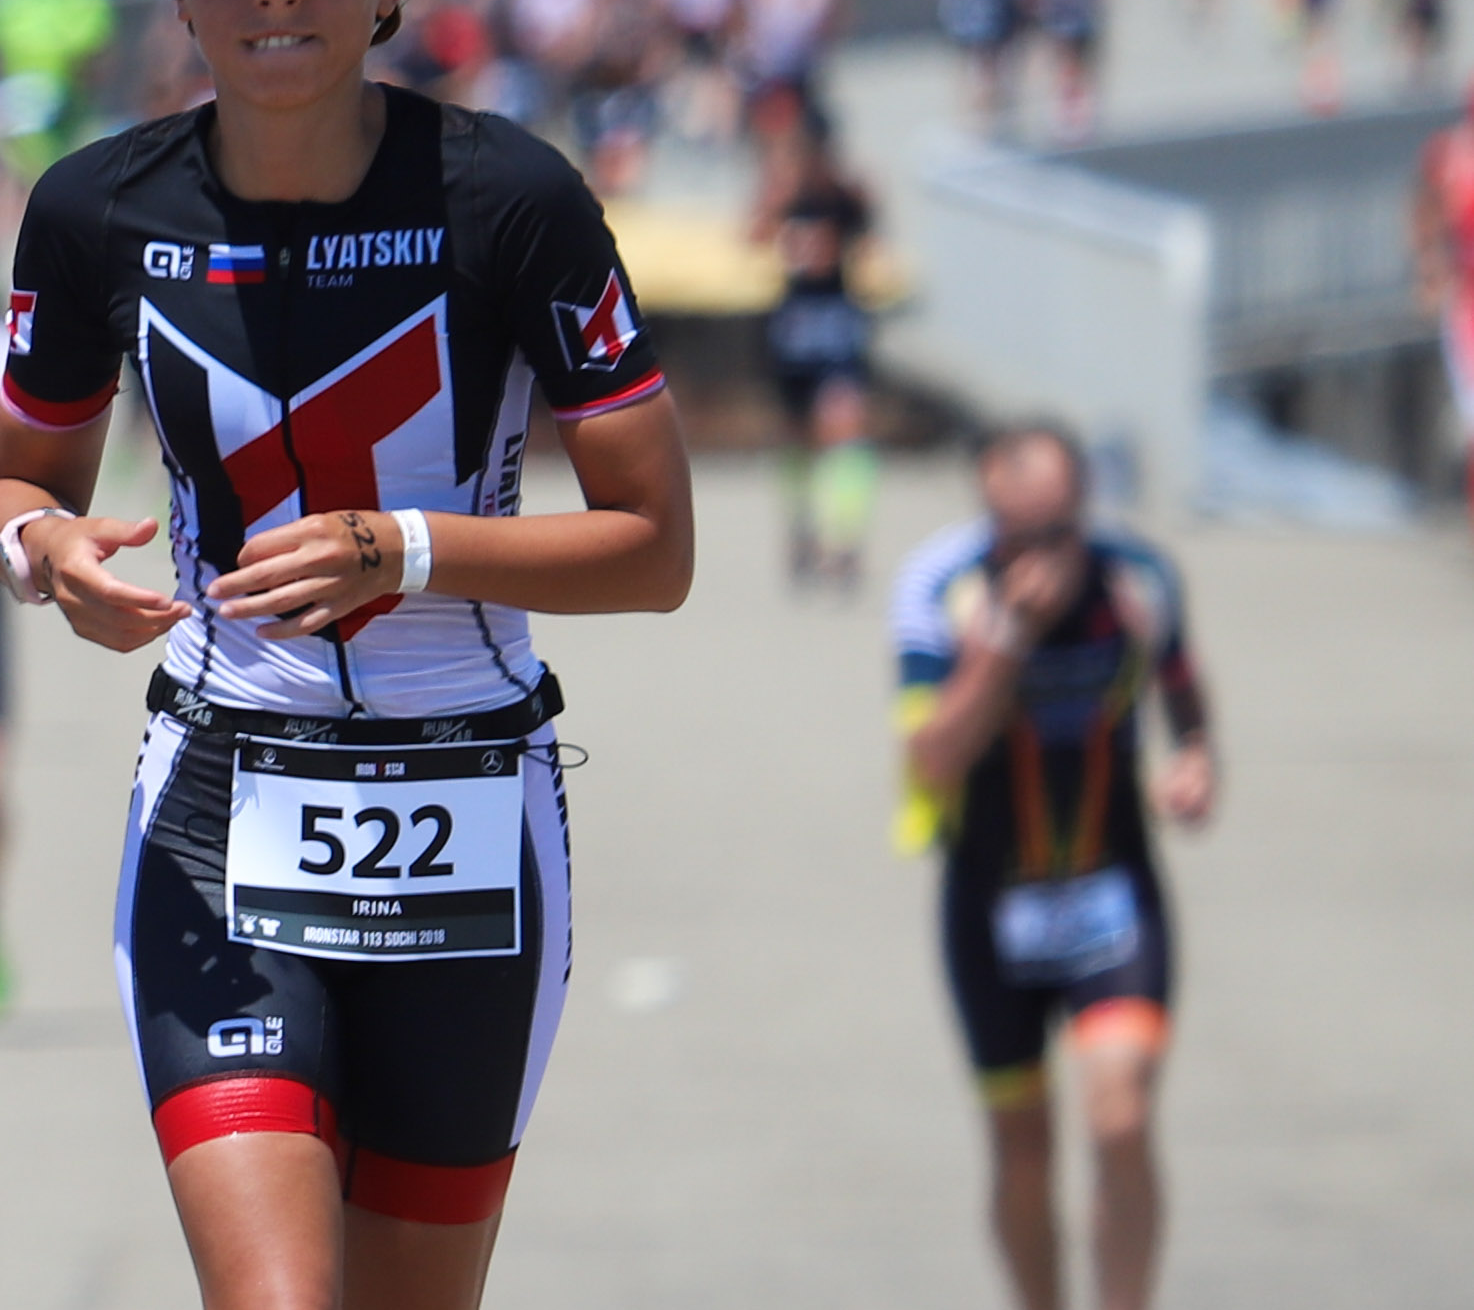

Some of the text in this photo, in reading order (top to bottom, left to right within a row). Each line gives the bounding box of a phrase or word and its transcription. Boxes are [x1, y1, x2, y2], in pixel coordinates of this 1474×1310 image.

[306, 227, 445, 270] LYATSKIY
[307, 273, 355, 288] TEAM
[339, 512, 382, 573] 522
[174, 688, 199, 706] RUN
[187, 708, 214, 727] LAB
[298, 803, 455, 879] 522
[352, 899, 403, 917] IRINA
[303, 925, 447, 947] IRONSTAR 113 SOCHI 2018
